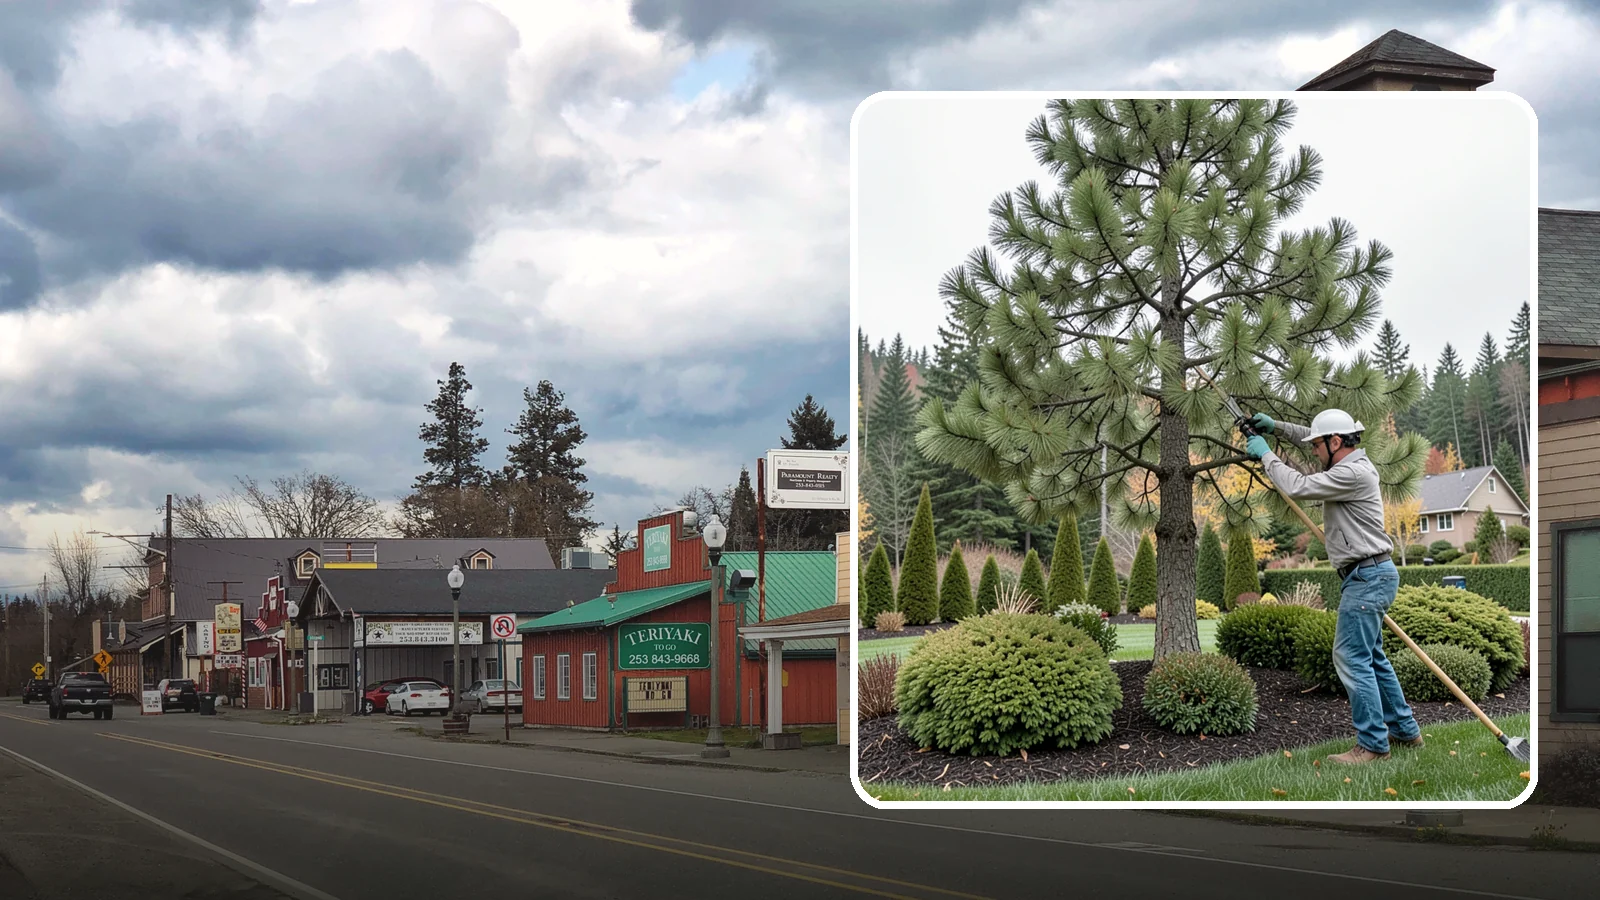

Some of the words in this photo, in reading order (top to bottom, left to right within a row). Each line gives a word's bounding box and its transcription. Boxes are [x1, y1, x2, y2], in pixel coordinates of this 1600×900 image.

[624, 627, 703, 646] TERIYAKI
[629, 654, 649, 665] 253
[651, 654, 700, 664] 843-9668
